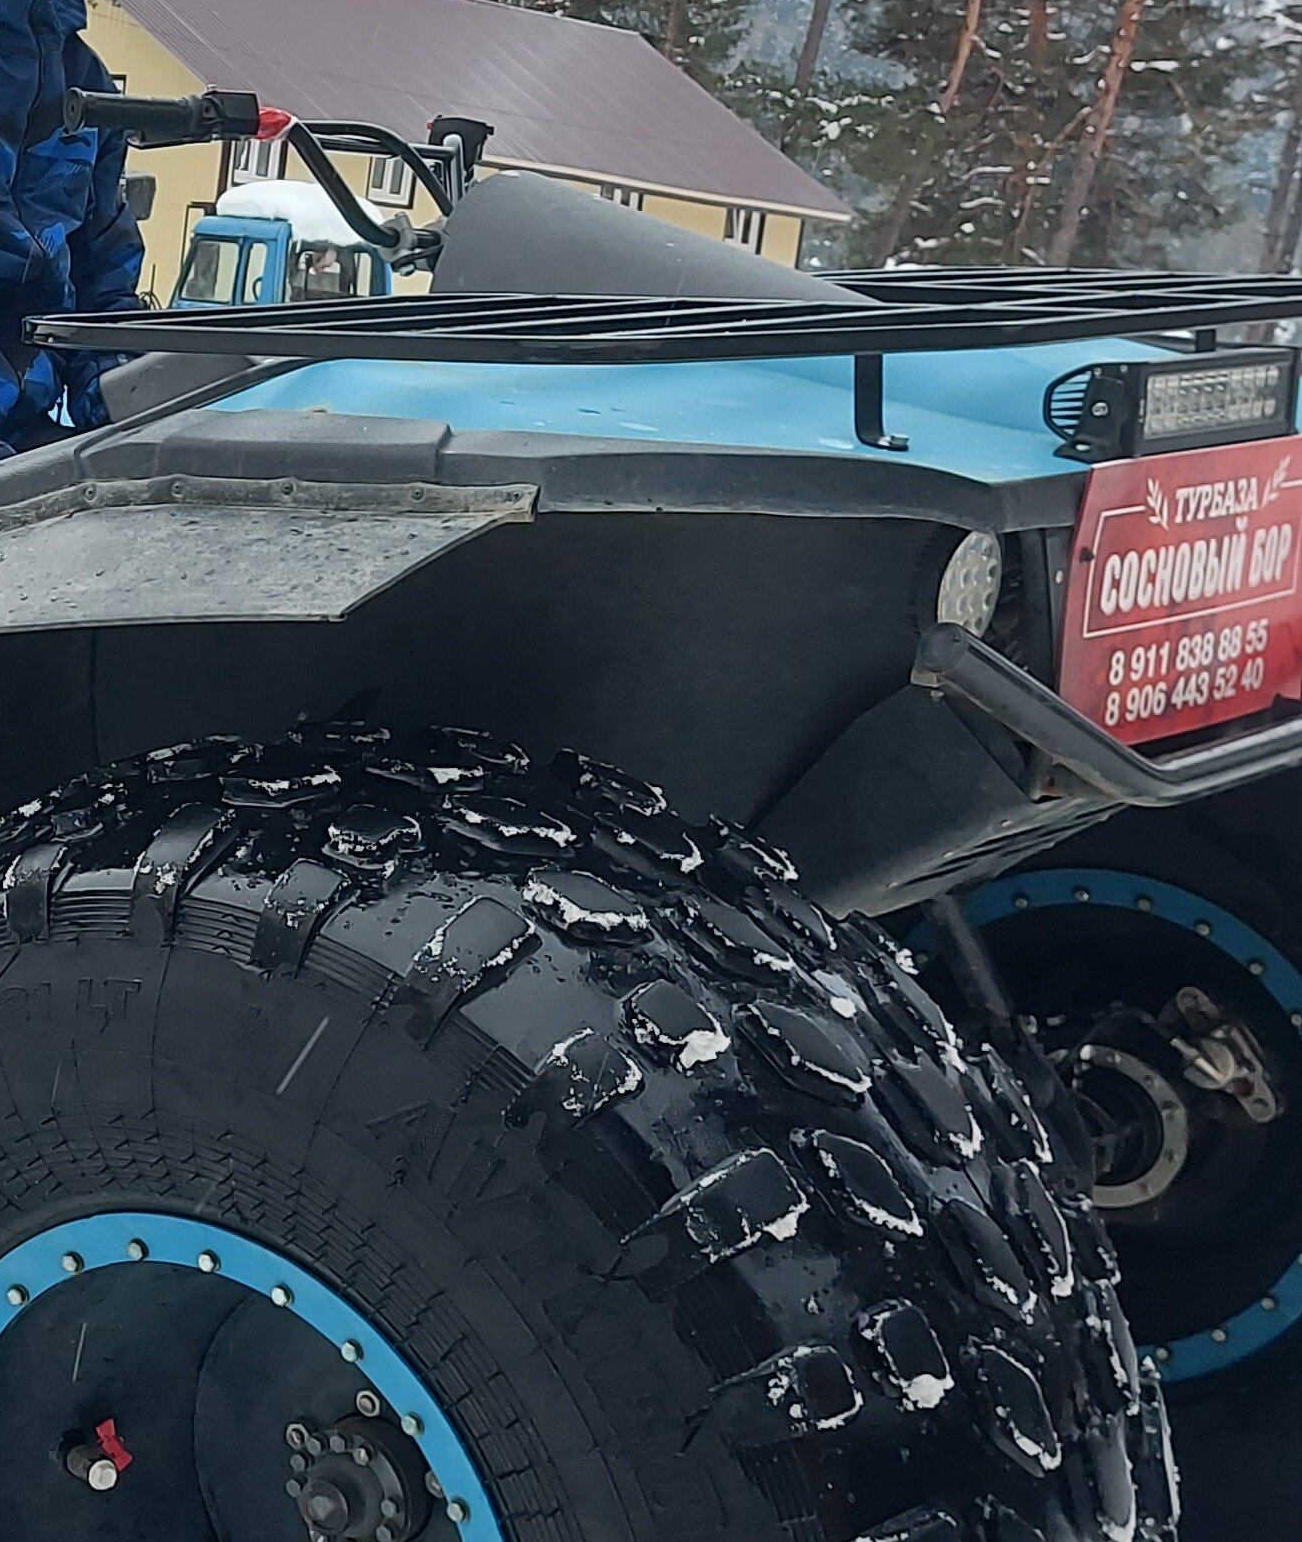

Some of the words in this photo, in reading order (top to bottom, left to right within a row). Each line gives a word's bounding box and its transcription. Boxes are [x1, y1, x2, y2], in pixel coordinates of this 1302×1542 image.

[1174, 477, 1259, 523] ТУРБАЗА
[1100, 515, 1248, 616] СОСНОВЫЙ
[1249, 523, 1292, 588] БОР
[1109, 650, 1125, 686] 8
[1130, 641, 1170, 681] 911
[1175, 631, 1215, 671] 838
[1217, 624, 1243, 661] 88
[1245, 618, 1269, 654] 55
[1104, 691, 1121, 726] 8
[1125, 681, 1167, 722] 906
[1171, 671, 1210, 709] 443
[1213, 664, 1238, 700] 52
[1241, 657, 1265, 691] 40
